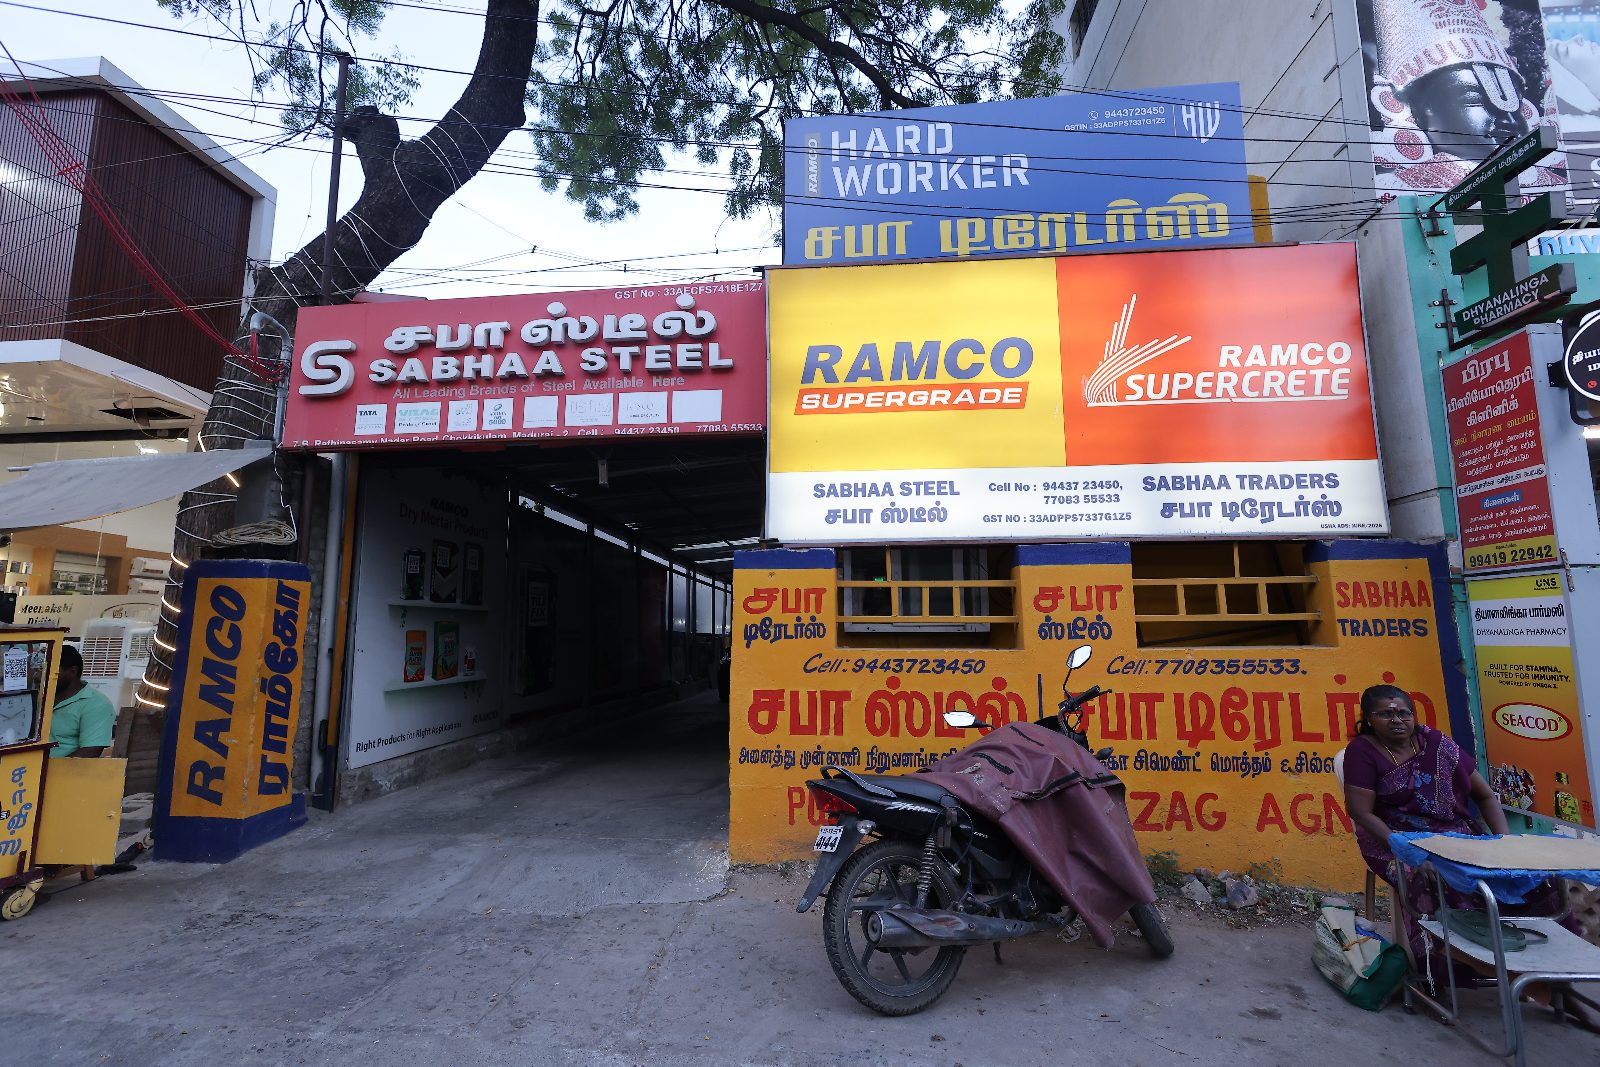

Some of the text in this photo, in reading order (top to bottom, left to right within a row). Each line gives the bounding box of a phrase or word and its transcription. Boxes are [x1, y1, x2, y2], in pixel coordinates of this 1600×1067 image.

[1105, 106, 1165, 119] 9443723450
[1064, 123, 1088, 131] GSTIN
[831, 122, 954, 162] HARD
[806, 138, 819, 195] RAMCO
[831, 153, 1030, 198] WORKER
[804, 193, 1229, 260] சபா டிரேடர்ஸ்
[614, 290, 637, 299] GST
[640, 289, 654, 298] No
[1462, 273, 1549, 322] DHYANALINGA
[1473, 288, 1539, 325] PHARMACY
[384, 293, 717, 354] சபா ஸ்டீல்
[368, 342, 734, 386] SABHAA STEEL
[801, 336, 1034, 384] RAMCO
[1219, 341, 1352, 368] RAMCO
[1462, 350, 1511, 384] பிரபு
[393, 374, 685, 399] All Leading Brands of Steel Available Here
[1125, 367, 1351, 400] SUPERCRETE
[1448, 366, 1534, 412] பிஸியோதெரபி
[801, 388, 1022, 410] SUPERGRADE
[1466, 394, 1519, 427] கிளினிக்
[578, 428, 598, 436] Cell
[812, 480, 960, 499] SABHAA STEEL
[988, 481, 1013, 493] Cell
[1014, 481, 1031, 493] No
[1042, 481, 1079, 492] 94437
[1143, 472, 1340, 493] SABHAA TRADERS
[824, 500, 949, 525] சபா ஸ்டீல்
[1043, 493, 1120, 506] 77083 55533
[1160, 493, 1343, 524] சபா டிரேடர்ஸ்
[982, 514, 1004, 524] GST
[1005, 513, 1022, 523] NO
[1470, 550, 1507, 567] 99419
[1511, 544, 1553, 562] 22942
[743, 587, 826, 615] சபா
[1033, 584, 1123, 613] சபா
[1335, 579, 1432, 608] SABHAA
[1475, 603, 1564, 621] தியானலிங்கா பார்மஸி
[743, 615, 827, 648] டிரேடர்ஸ்
[1037, 614, 1113, 641] ஸ்டீல்
[1336, 618, 1429, 638] TRADERS
[1476, 627, 1567, 636] DHYANALINGA PHARMACY
[1484, 670, 1571, 683] TRUSTED FOR IMMUNITY.
[1525, 665, 1562, 673] STAMINA.
[186, 584, 247, 806] RAMCO
[258, 579, 302, 796] ராம்கோ
[747, 688, 852, 737] சபா
[1501, 713, 1559, 732] SEACOD
[355, 740, 376, 753] Right
[377, 732, 406, 748] Products
[416, 727, 431, 739] Right
[738, 744, 796, 769] அனைத்து
[1133, 748, 1202, 773] சிமெண்ட்
[1210, 750, 1272, 778] மொத்தம்
[1130, 790, 1227, 833] ZAG
[1255, 792, 1353, 835] AGN
